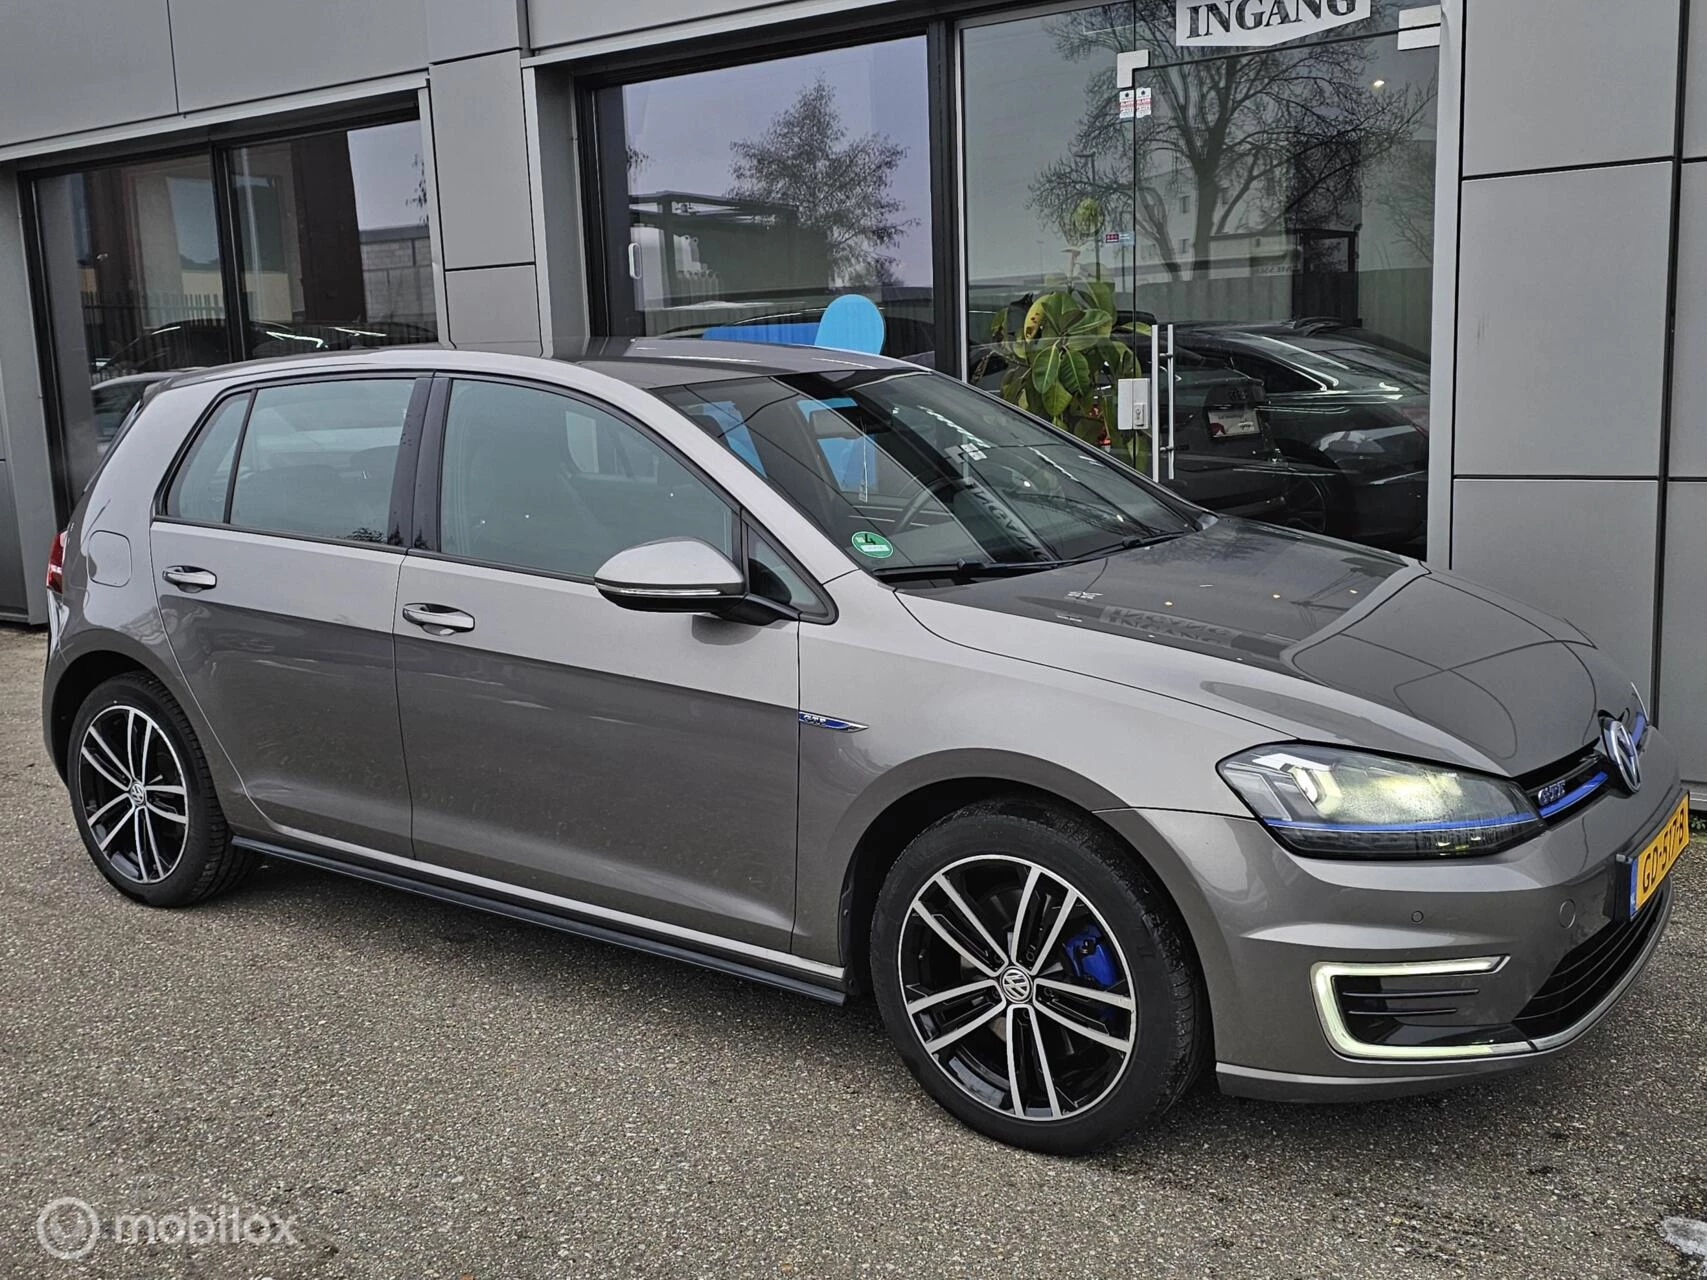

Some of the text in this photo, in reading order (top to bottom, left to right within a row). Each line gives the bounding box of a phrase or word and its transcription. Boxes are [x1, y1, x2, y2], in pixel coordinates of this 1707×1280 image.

[1186, 0, 1356, 39] INGANG
[1537, 779, 1566, 806] GTE
[1642, 807, 1684, 894] GD-517-B
